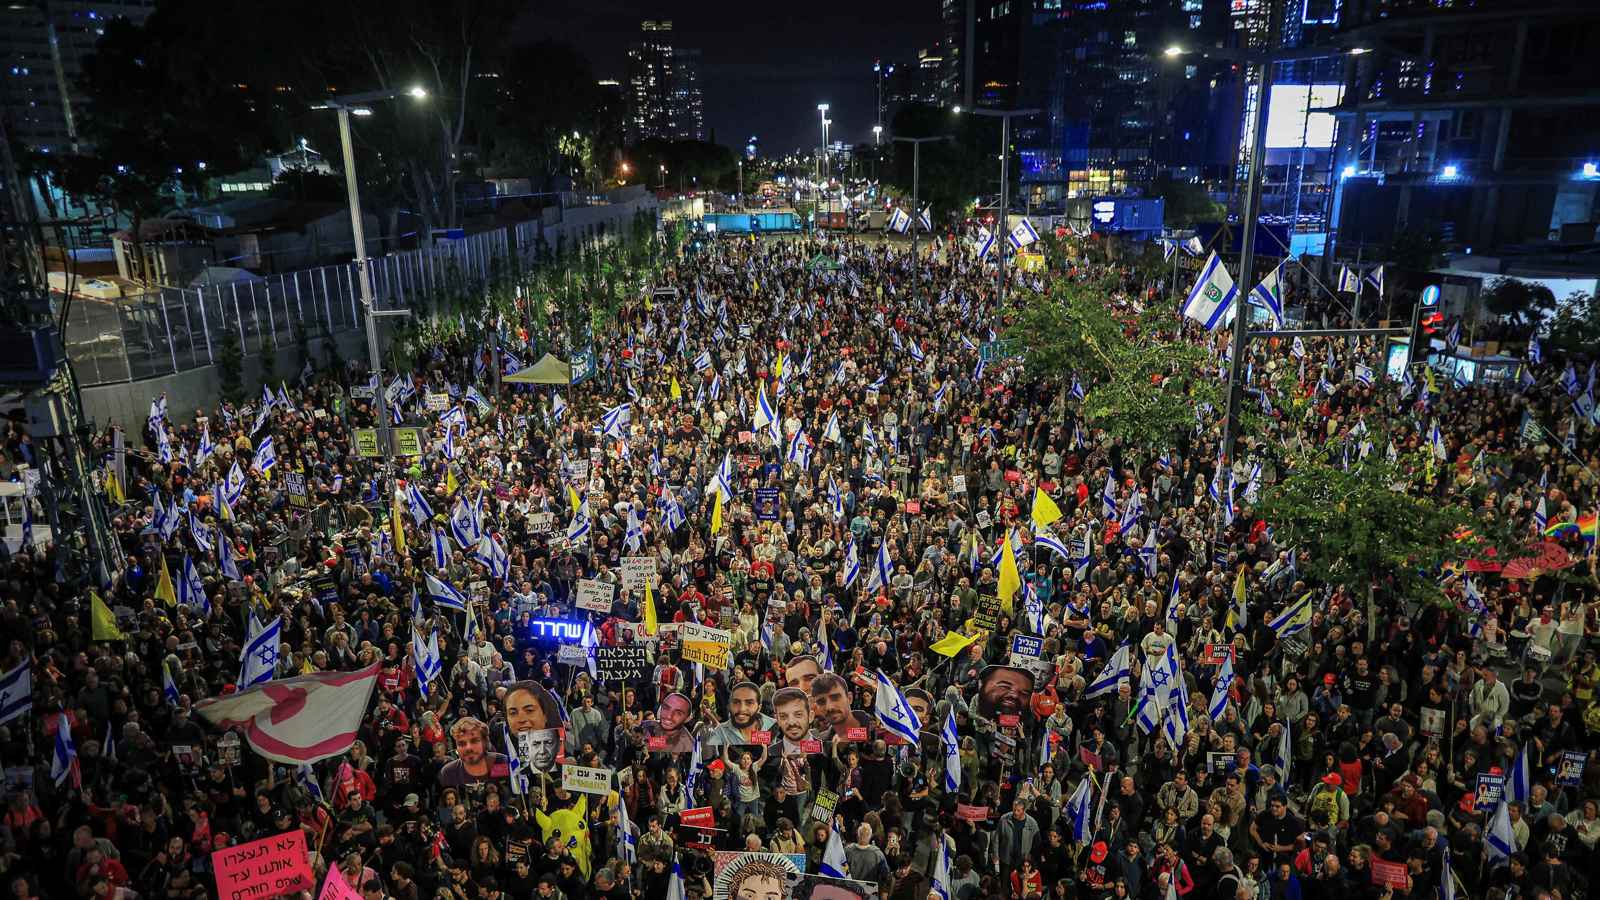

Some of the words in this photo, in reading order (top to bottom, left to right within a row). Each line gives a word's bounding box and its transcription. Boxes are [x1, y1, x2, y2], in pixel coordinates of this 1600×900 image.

[533, 620, 581, 638] שחרר
[1018, 637, 1039, 648] הגליל
[717, 645, 729, 656] על
[1018, 645, 1036, 655] נלחם
[600, 658, 645, 668] המדינה
[597, 669, 642, 680] מעצמה
[595, 772, 607, 781] מה
[277, 838, 295, 851] לא
[224, 845, 269, 867] תעצרו
[258, 857, 293, 875] אותנו
[229, 868, 250, 883] עד
